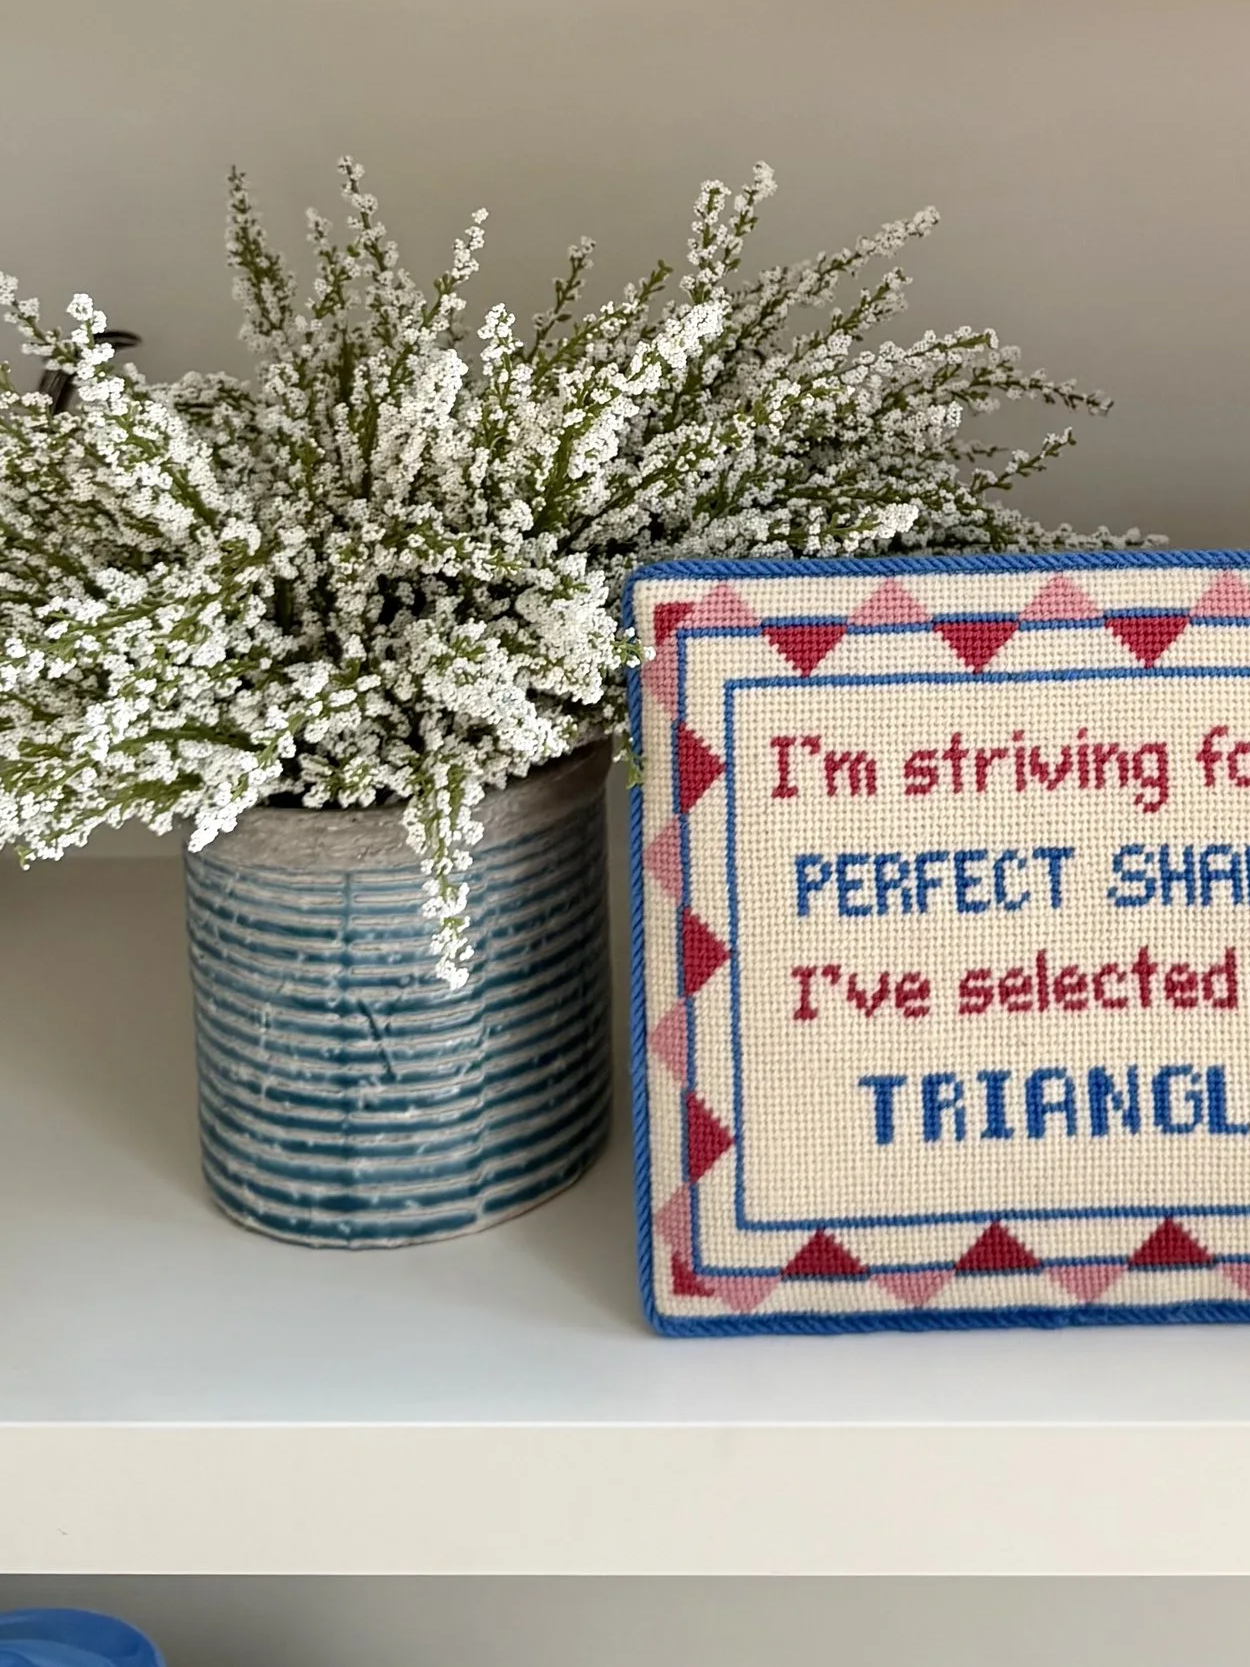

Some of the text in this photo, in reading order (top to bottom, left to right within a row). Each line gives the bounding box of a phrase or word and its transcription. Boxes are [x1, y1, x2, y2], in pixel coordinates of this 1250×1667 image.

[769, 734, 878, 799] I'm
[903, 726, 1170, 814] striving
[794, 845, 1076, 918] PERFECT
[790, 963, 932, 1022] I've
[957, 944, 1238, 1017] selected
